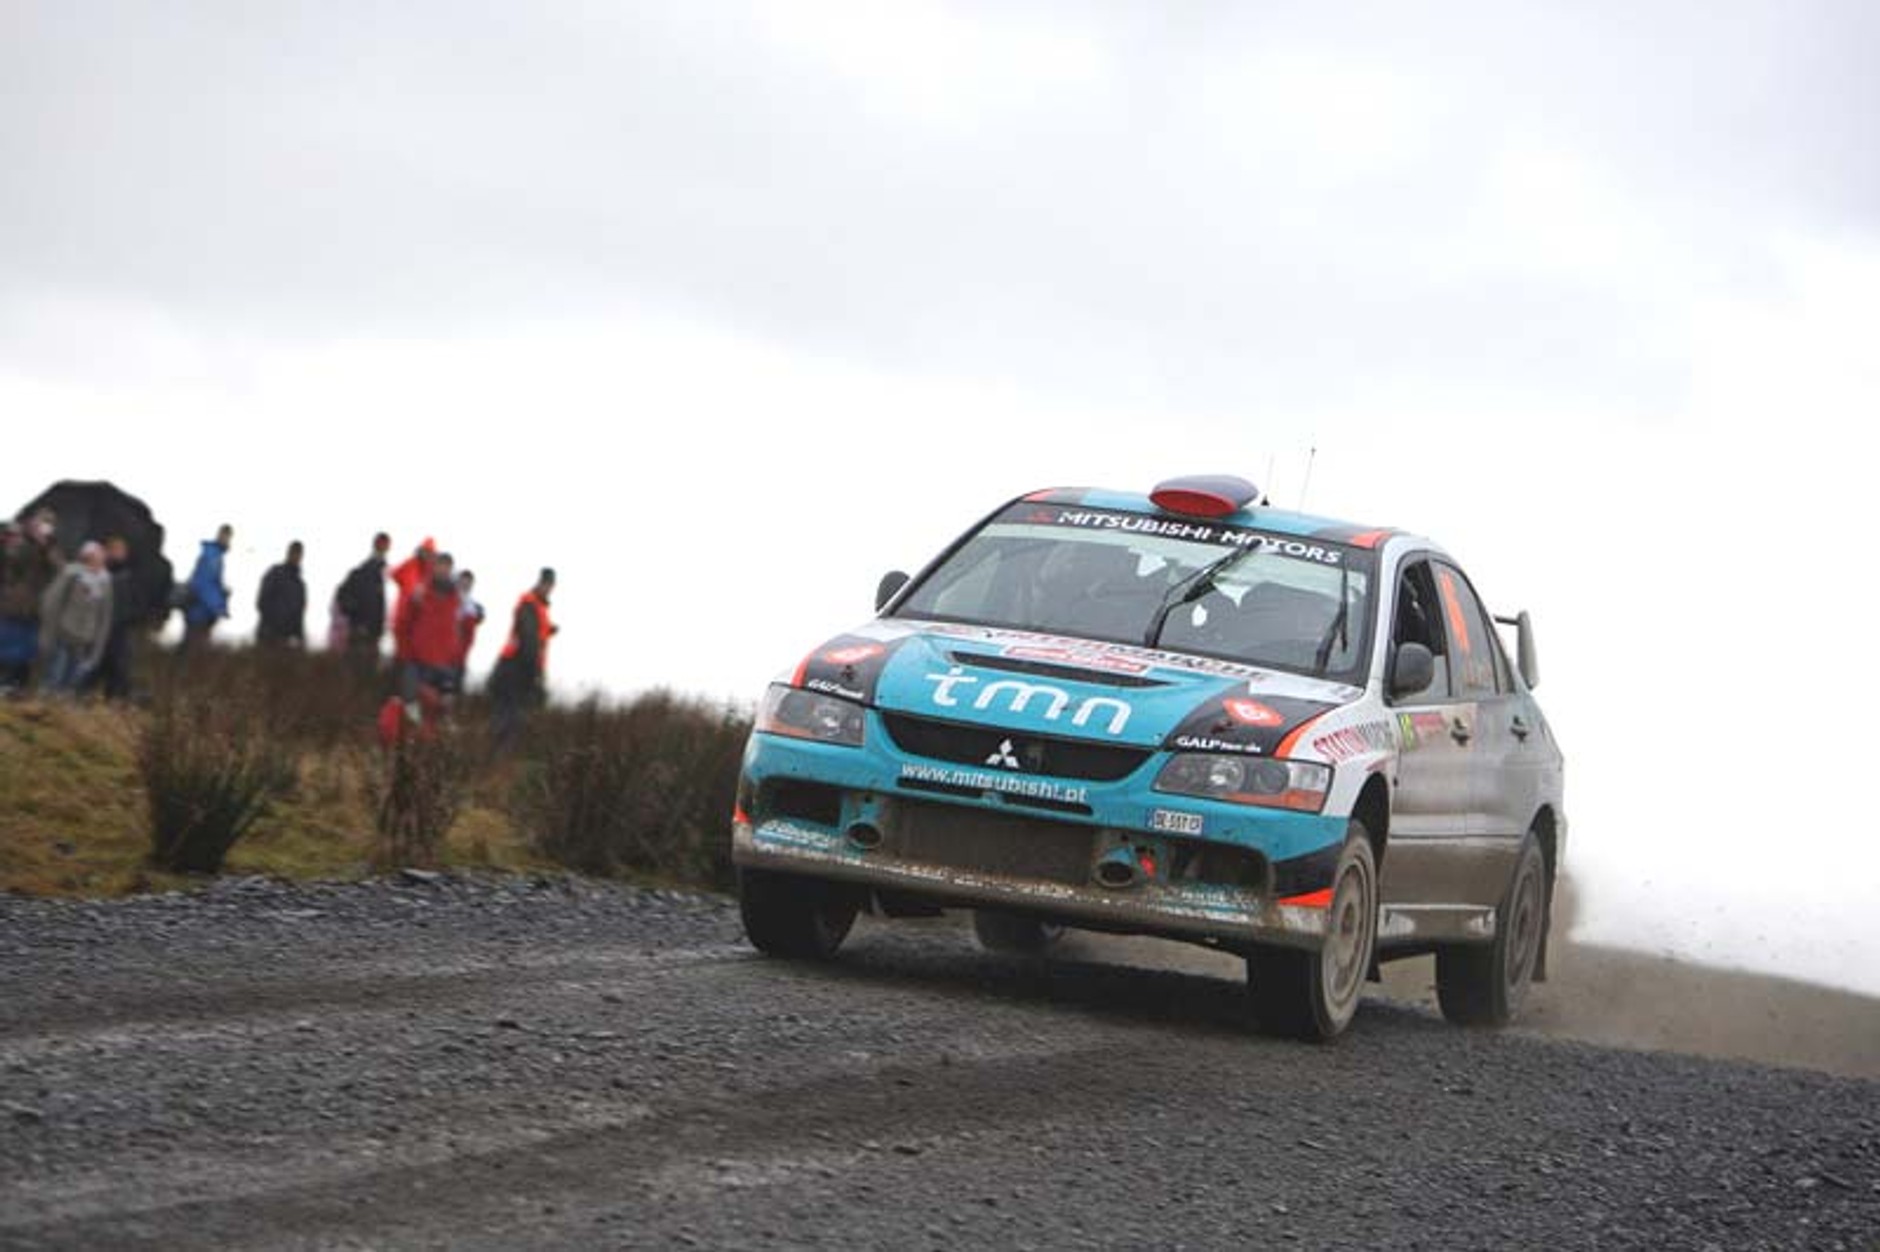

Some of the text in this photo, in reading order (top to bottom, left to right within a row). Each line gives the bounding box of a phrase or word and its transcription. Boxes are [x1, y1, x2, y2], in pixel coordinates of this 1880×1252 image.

[1057, 510, 1343, 564] MITSUBISHI MOTORS
[924, 666, 1132, 735] tmn
[901, 762, 1089, 804] www.mitsubishi.pt
